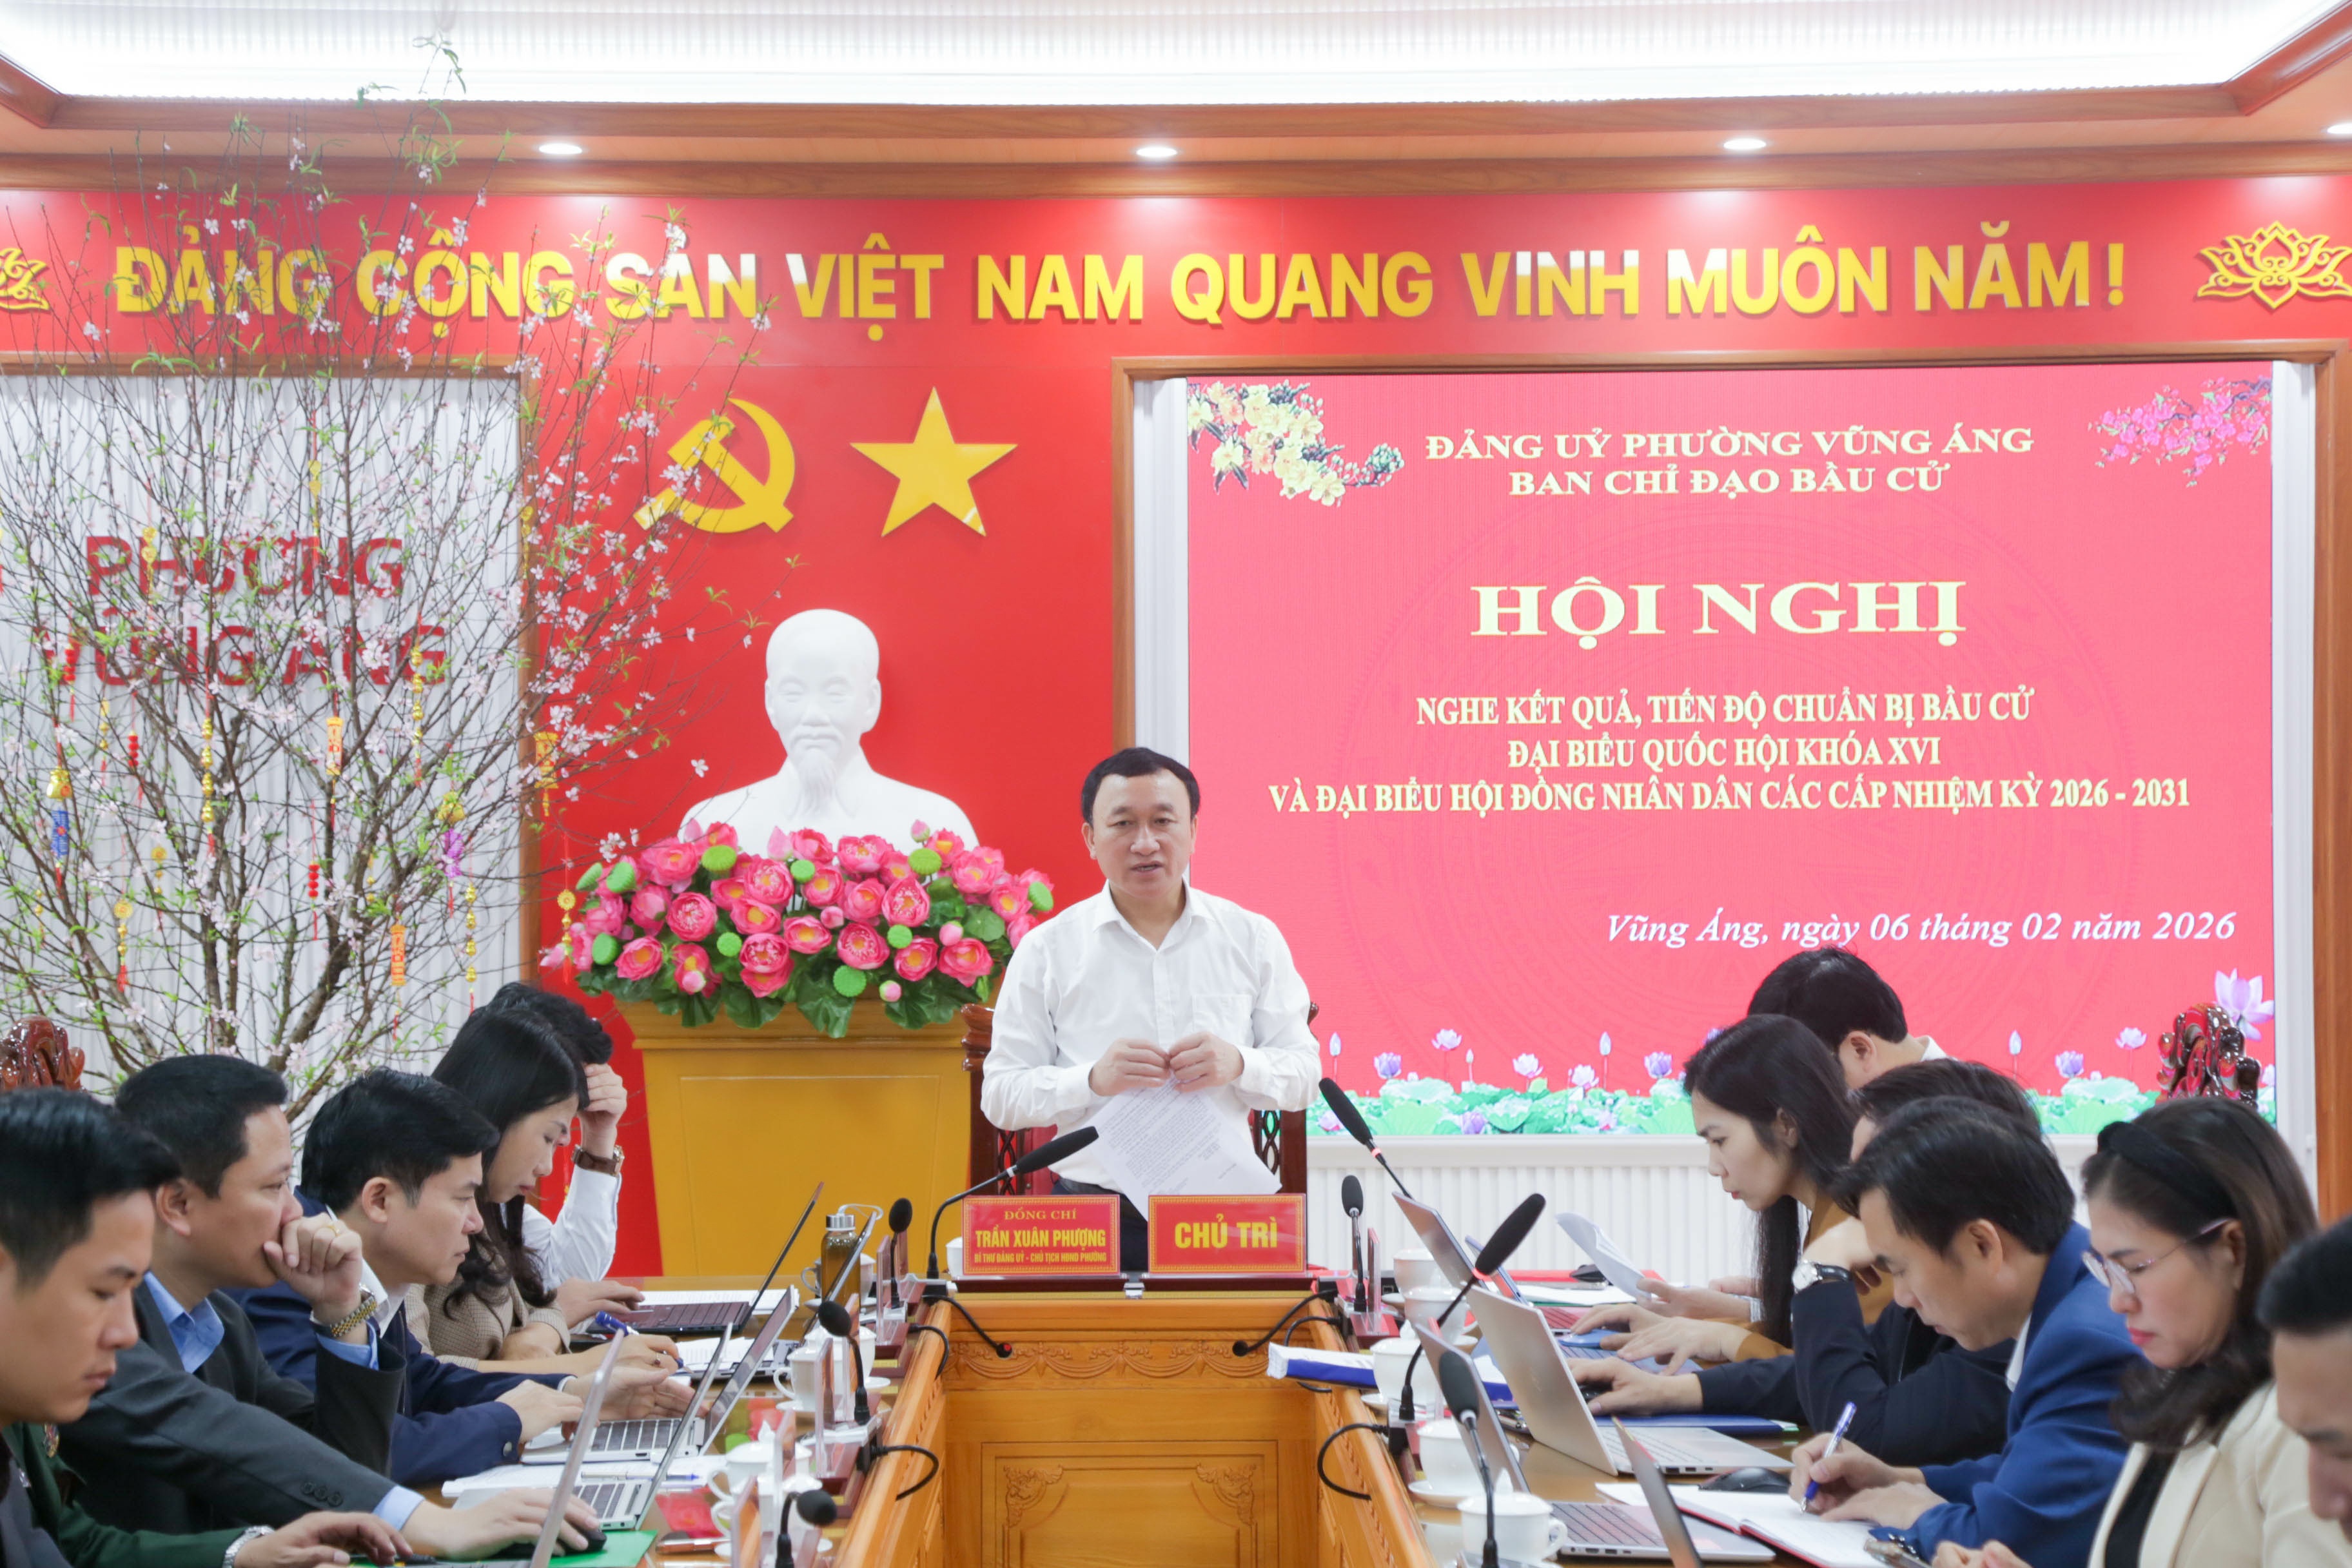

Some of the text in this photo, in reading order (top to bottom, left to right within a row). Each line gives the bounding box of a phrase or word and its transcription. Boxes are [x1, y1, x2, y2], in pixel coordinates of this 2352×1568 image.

[112, 224, 333, 318] ĐẢNG
[357, 228, 576, 339] CỘNG
[785, 233, 945, 341] VIỆT
[977, 253, 1144, 320] NAM
[1170, 251, 1434, 325] QUANG
[1460, 249, 1639, 316] VINH
[1667, 224, 1888, 315] MUÔN
[1914, 220, 2090, 311] NĂM
[1426, 428, 1544, 460] ĐẢNG
[1622, 426, 1803, 458] PHƯỜNG
[1811, 424, 1932, 456] VŨNG
[1941, 422, 2034, 454] ÁNG
[1509, 460, 1952, 500] BAN CHỈ ĐẠO BẦU CỬ
[1470, 576, 1966, 650] HỘI NGHỊ
[1416, 684, 2035, 729] NGHE KẾT QUẢ, TIẾN ĐỘ CHUẨN BỊ BẦU CỬ
[1507, 730, 1941, 774] ĐẠI BIỂU QUỐC HỘI KHÓA XVI
[1268, 777, 1311, 812] VÀ
[1315, 785, 1368, 819] ĐẠI
[1374, 776, 1443, 812] BIỂU
[1449, 779, 1505, 818] HỘI
[1510, 774, 1596, 811] ĐỒNG
[1601, 774, 1685, 810] NHÂN
[1691, 774, 1753, 810] DÂN
[1759, 773, 1821, 809] CÁC
[1828, 772, 1888, 809] CẤP
[1892, 776, 1994, 816] NHIỆM
[1999, 771, 2043, 808] KỲ
[2050, 778, 2109, 807] 2026
[2132, 778, 2190, 807] 2031
[1608, 907, 2237, 948] Vũng Áng, ngày 06 tháng 02 năm 2026
[1050, 1208, 1077, 1220] CHÍ
[1174, 1213, 1279, 1249] CHỦ TRÌ
[975, 1224, 1106, 1251] TRẦN XUÂN PHƯỢNG
[983, 1251, 995, 1263] THƯ
[1030, 1250, 1044, 1263] CHỦ
[1044, 1252, 1060, 1264] TỊCH
